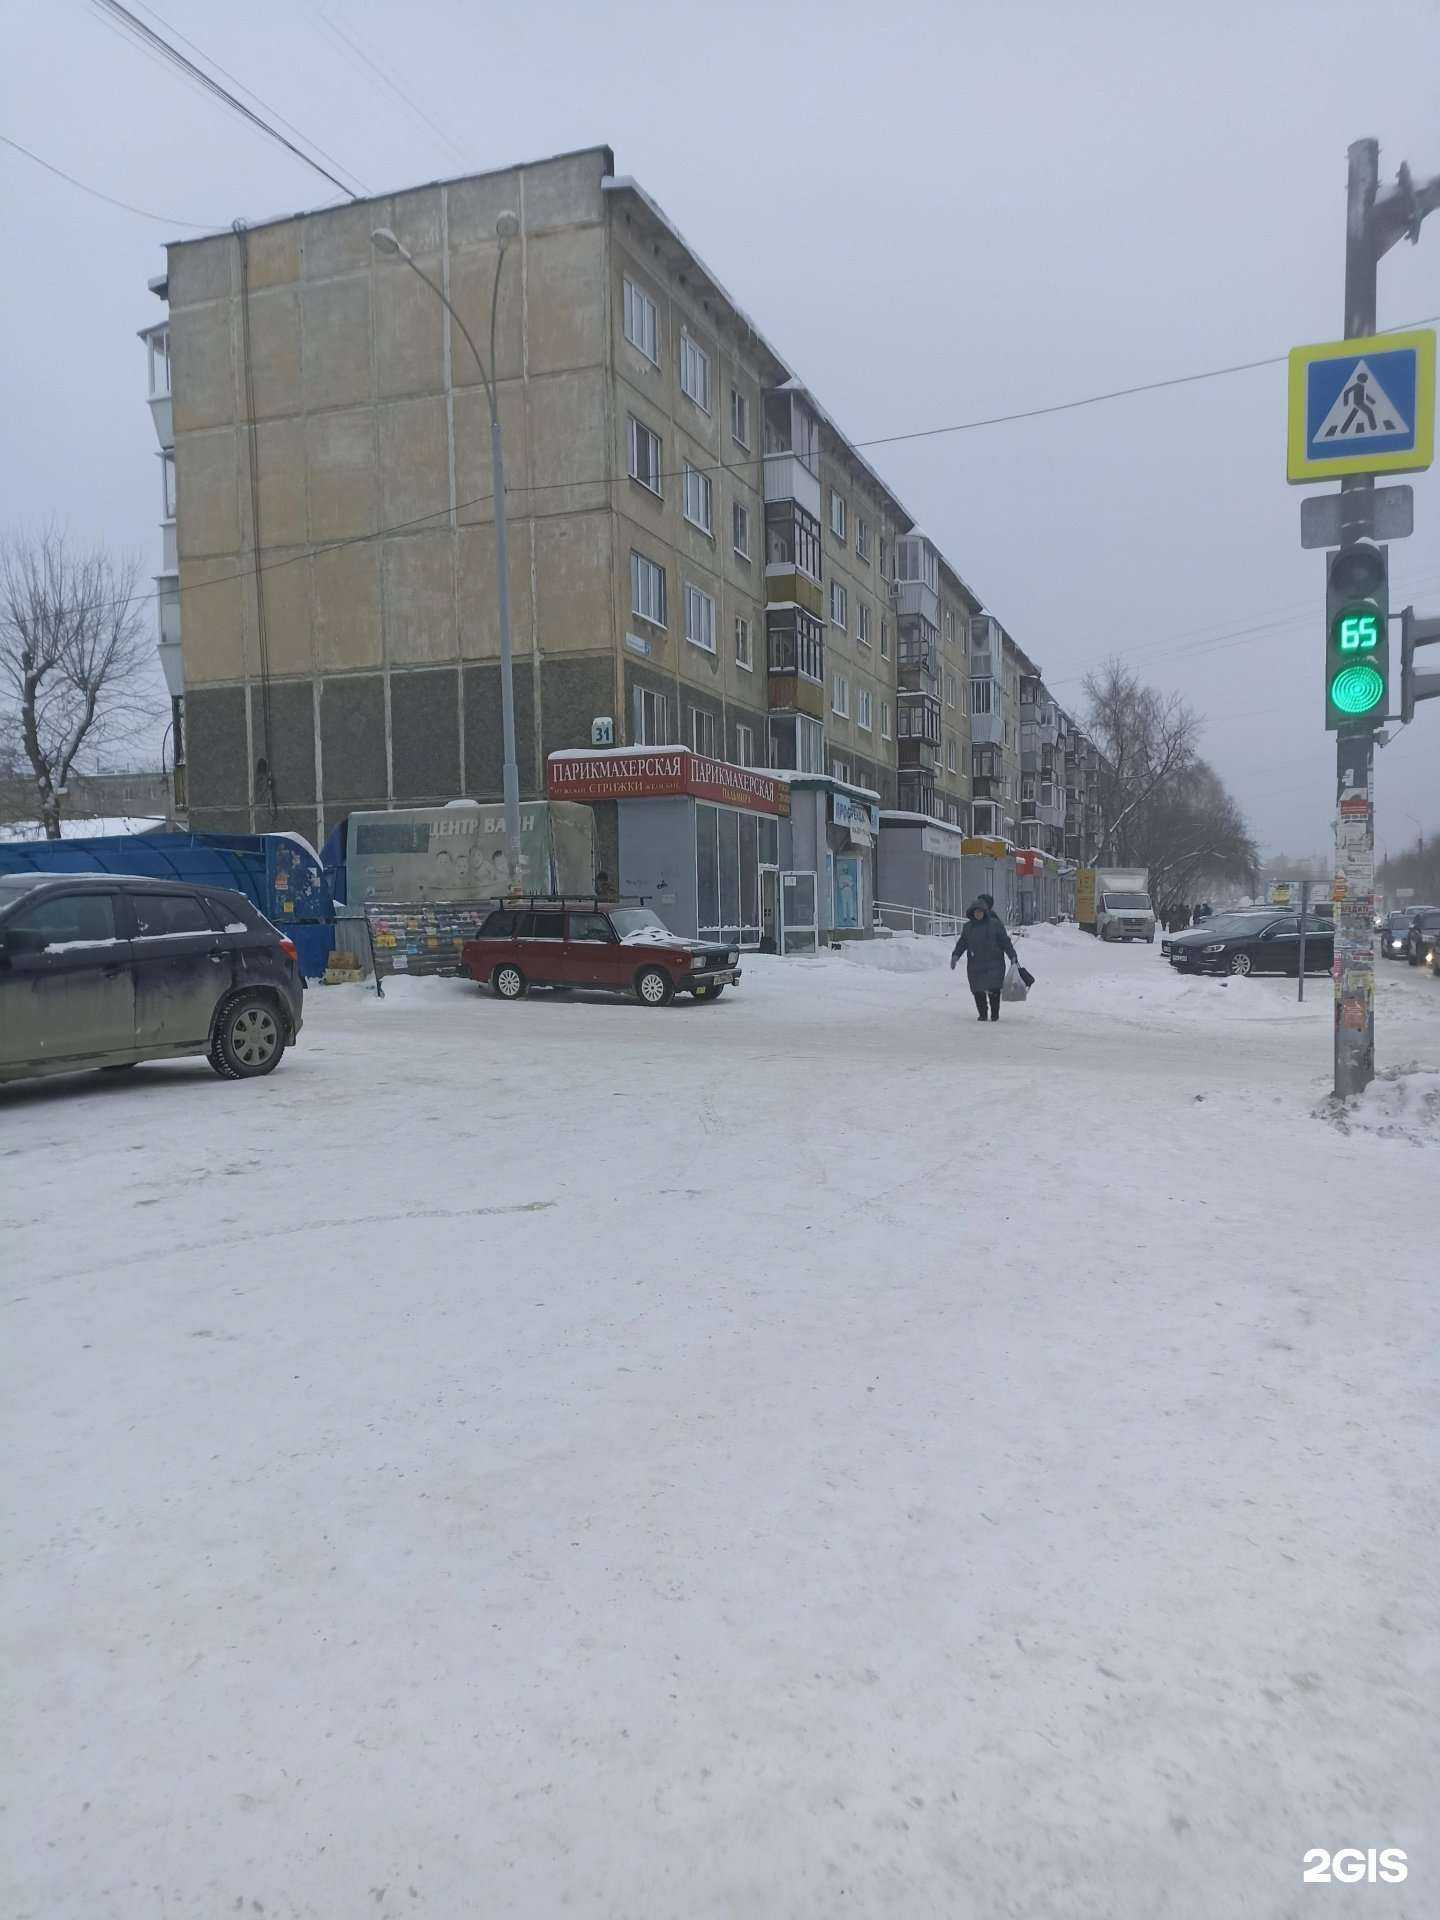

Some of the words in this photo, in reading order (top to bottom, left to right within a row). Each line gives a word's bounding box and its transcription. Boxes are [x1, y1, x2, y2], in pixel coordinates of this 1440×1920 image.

[1341, 617, 1377, 649] 65
[595, 727, 610, 741] 31
[553, 757, 681, 782] ПАРИКМАХЕРСКАЯ
[690, 759, 774, 803] ПАРИКМАХЕРСКАЯ
[589, 780, 643, 793] СТРИЖКИ
[430, 818, 479, 839] ЦЕНТР
[484, 815, 535, 834] ВАН
